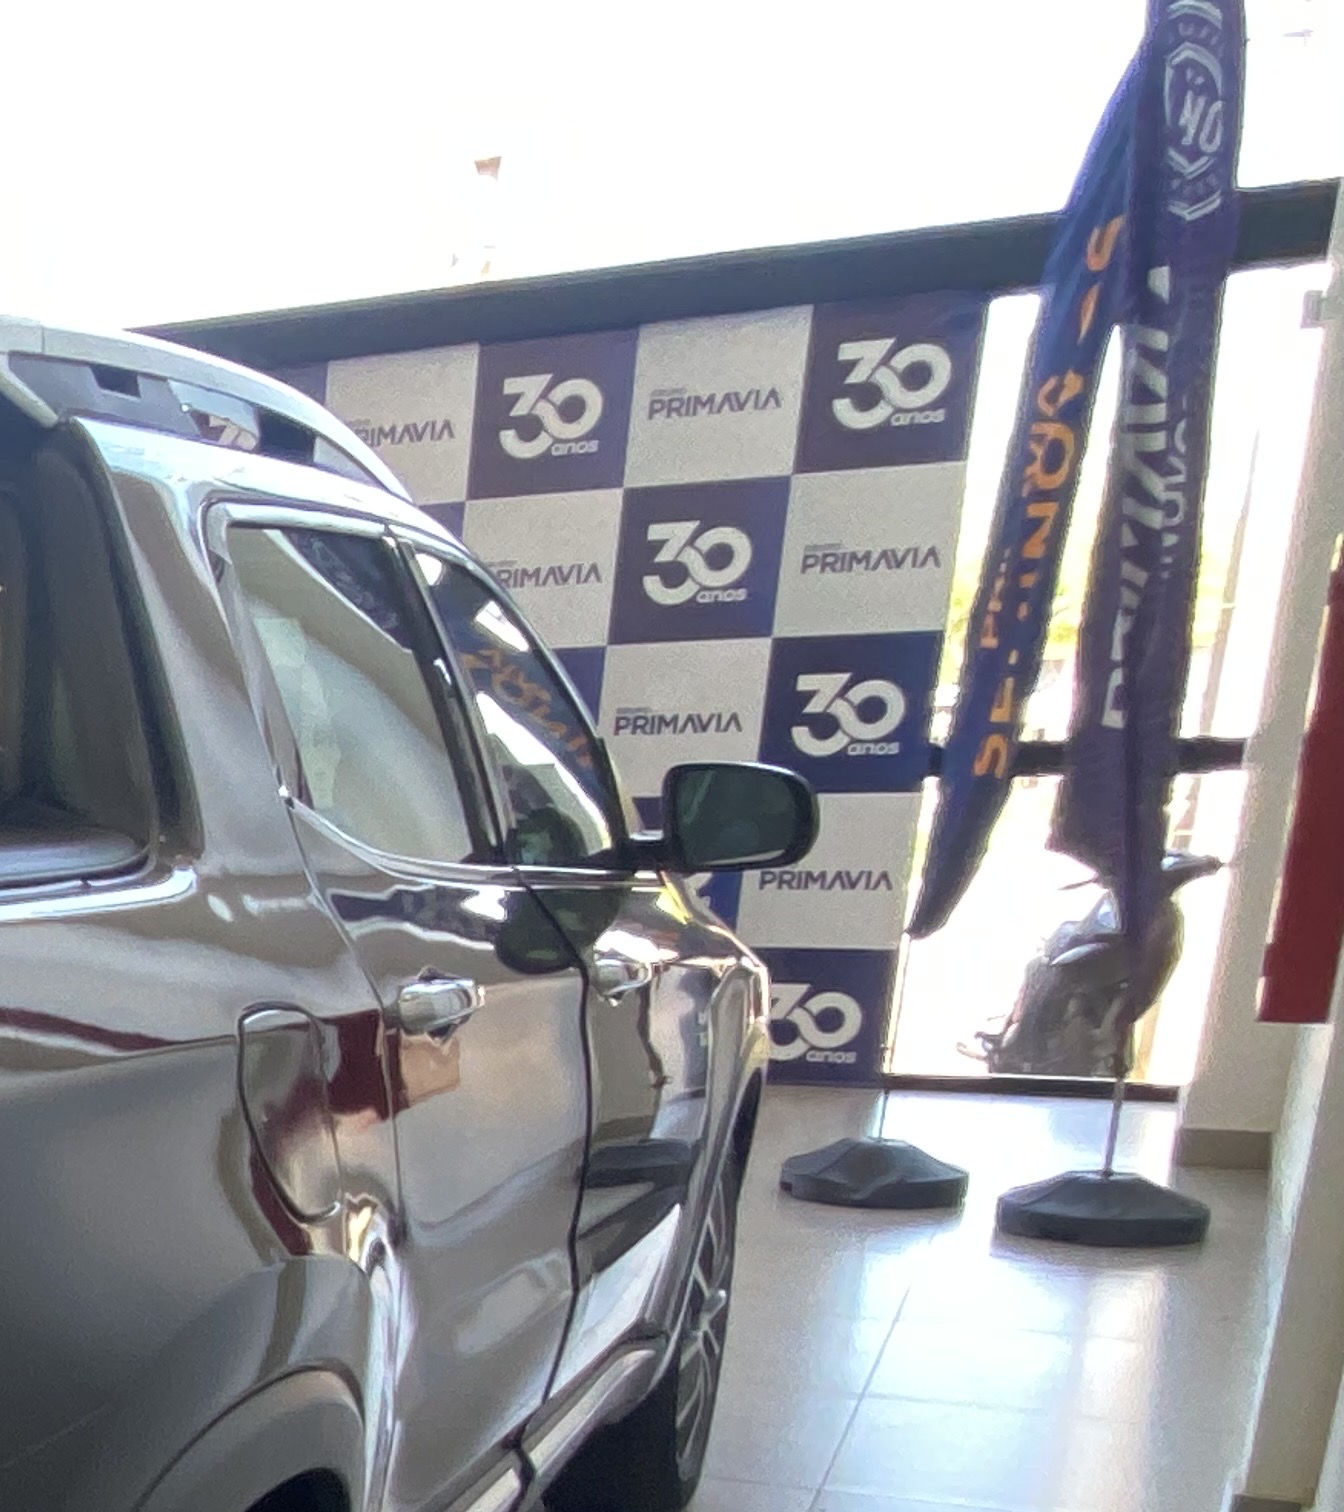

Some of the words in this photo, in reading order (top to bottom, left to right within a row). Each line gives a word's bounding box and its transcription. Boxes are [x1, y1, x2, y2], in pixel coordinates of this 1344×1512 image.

[831, 336, 952, 430] 30
[498, 373, 604, 459] 30
[647, 387, 783, 420] PRIMAVIA
[494, 562, 603, 589] RIMAVIA
[641, 520, 753, 606] 30
[799, 545, 942, 575] PRIMAVIA
[613, 711, 743, 737] PRIMAVIA
[790, 672, 906, 757] 30
[758, 869, 893, 891] PRIMAVIA
